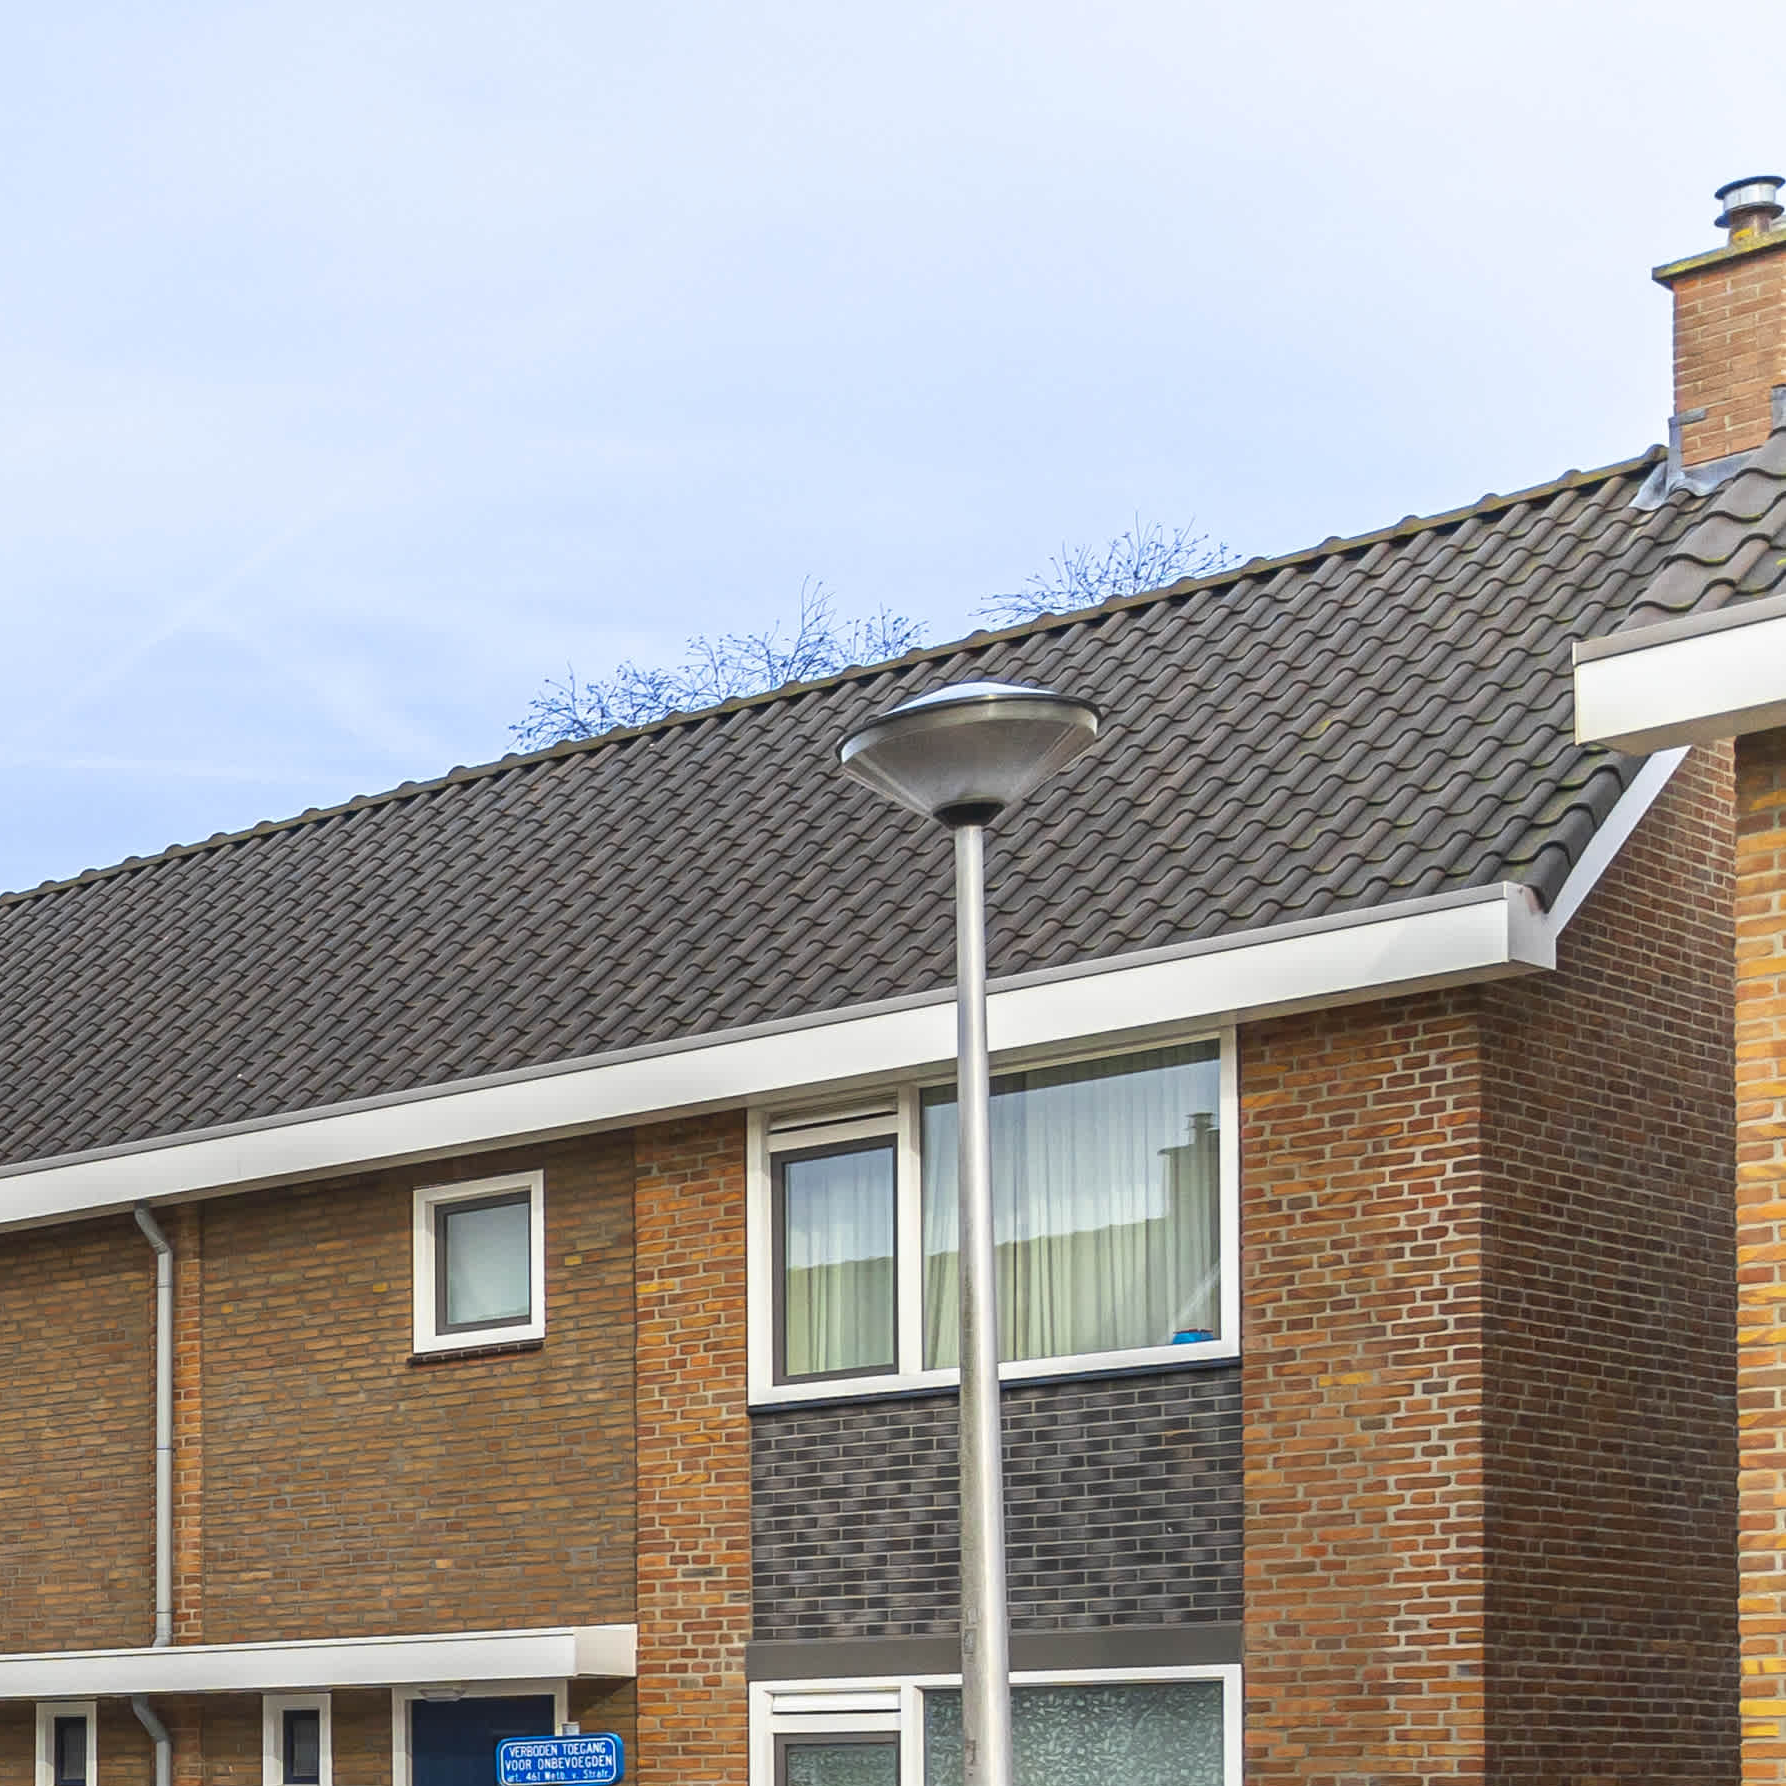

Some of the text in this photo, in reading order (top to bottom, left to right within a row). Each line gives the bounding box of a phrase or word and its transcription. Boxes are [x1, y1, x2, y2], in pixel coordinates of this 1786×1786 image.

[509, 1742, 606, 1758] VERBODEN TOEGANG
[505, 1755, 613, 1771] VOOR ONBEVOEGDEN
